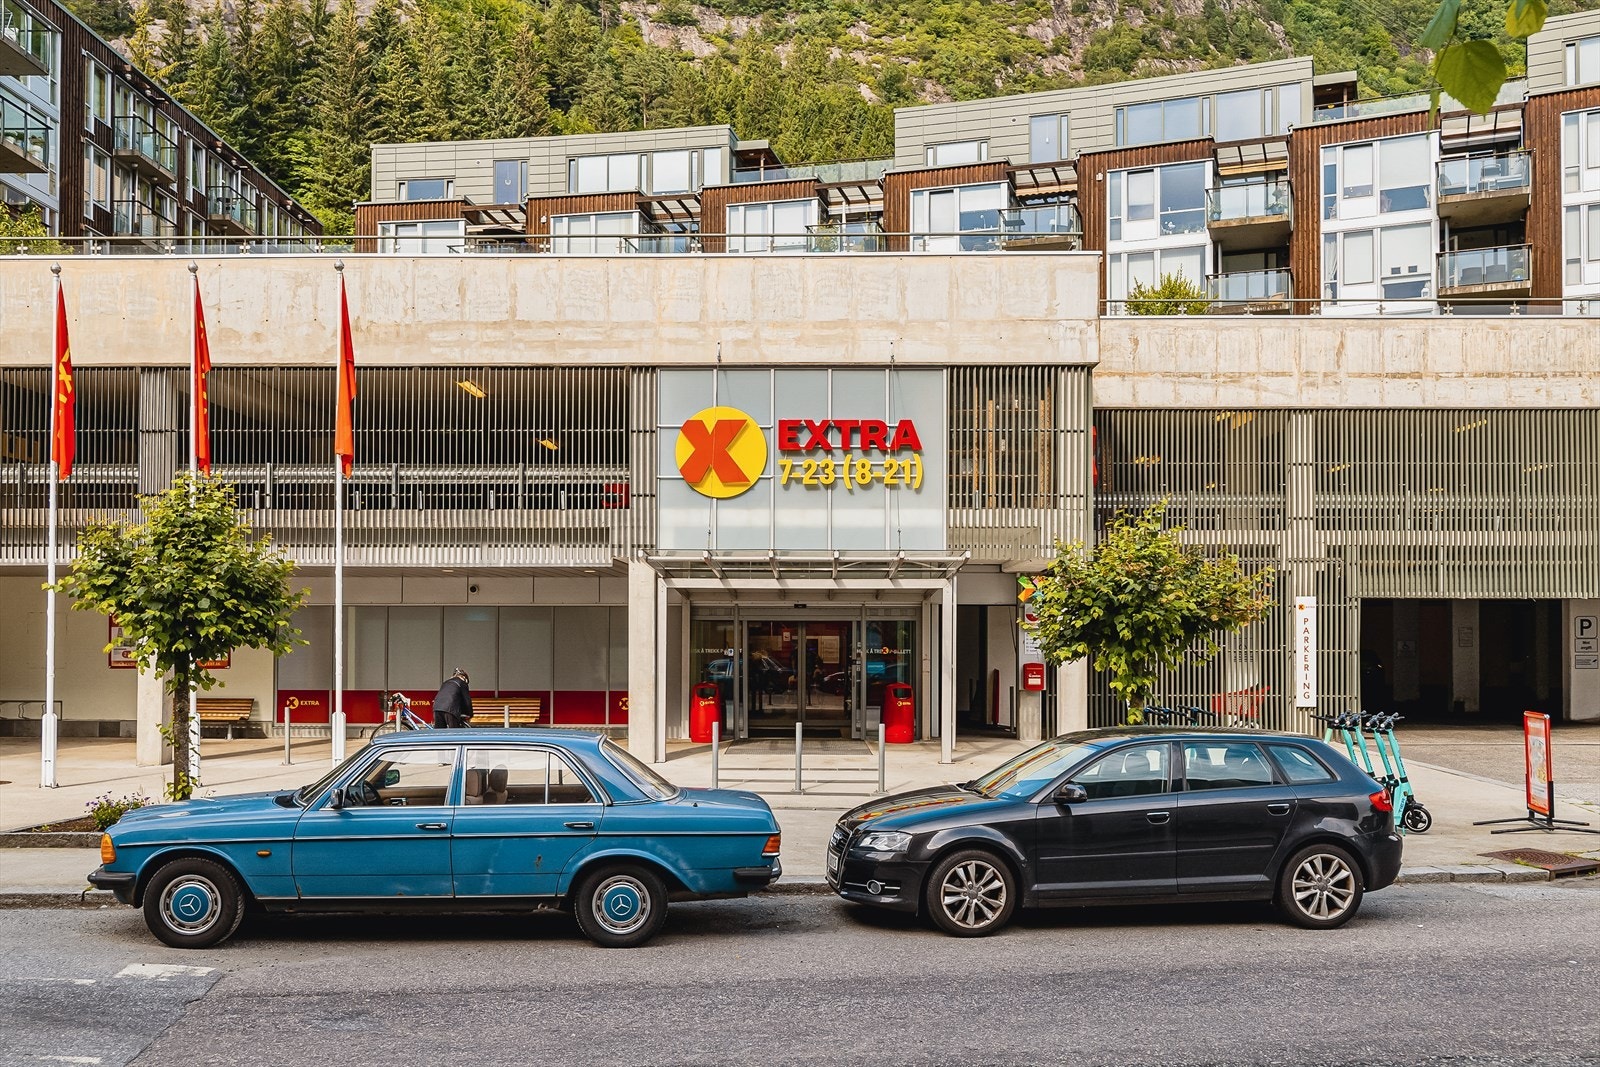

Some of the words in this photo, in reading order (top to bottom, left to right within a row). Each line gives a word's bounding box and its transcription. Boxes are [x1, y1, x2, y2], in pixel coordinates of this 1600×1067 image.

[778, 419, 923, 451] EXTRA
[778, 459, 835, 485] 7-23
[843, 453, 924, 489] (8-21)
[1580, 618, 1592, 636] P
[1302, 617, 1310, 700] PARKERING
